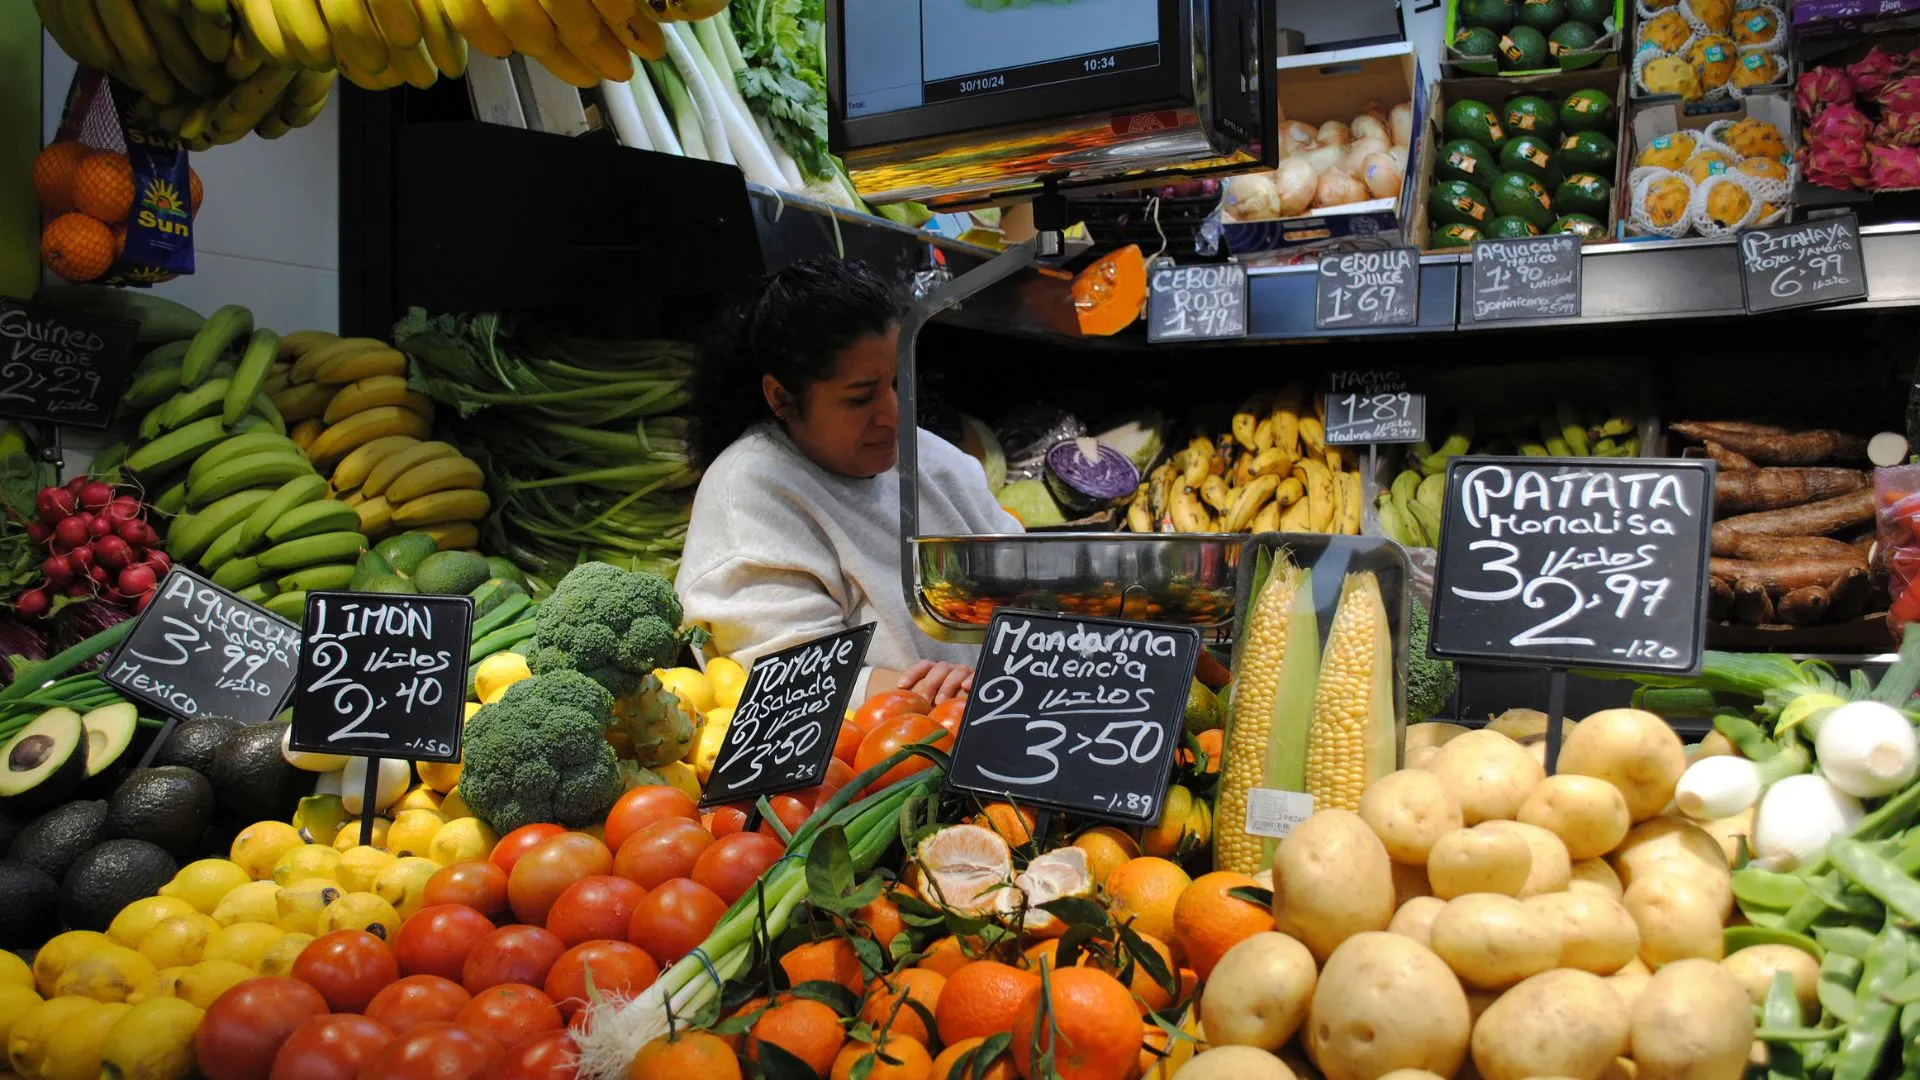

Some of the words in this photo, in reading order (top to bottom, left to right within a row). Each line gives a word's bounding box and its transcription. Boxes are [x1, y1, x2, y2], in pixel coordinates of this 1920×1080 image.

[1083, 55, 1116, 73] 10:34
[959, 74, 1005, 93] 30/10/24
[848, 101, 868, 113] Total:
[137, 209, 189, 238] Sun
[1476, 238, 1573, 262] Aguacate
[1742, 223, 1852, 263] PITAHAYA
[1320, 249, 1411, 277] CEBOLLA
[1346, 270, 1404, 290] DULCE
[11, 340, 92, 366] VERDE
[1462, 465, 1693, 529] PATATA
[1451, 540, 1524, 601] 3
[992, 620, 1176, 657] Mandarina
[307, 641, 353, 693] 2
[1003, 652, 1147, 682] Valencia
[970, 675, 1031, 726] 2
[718, 719, 760, 773] 2
